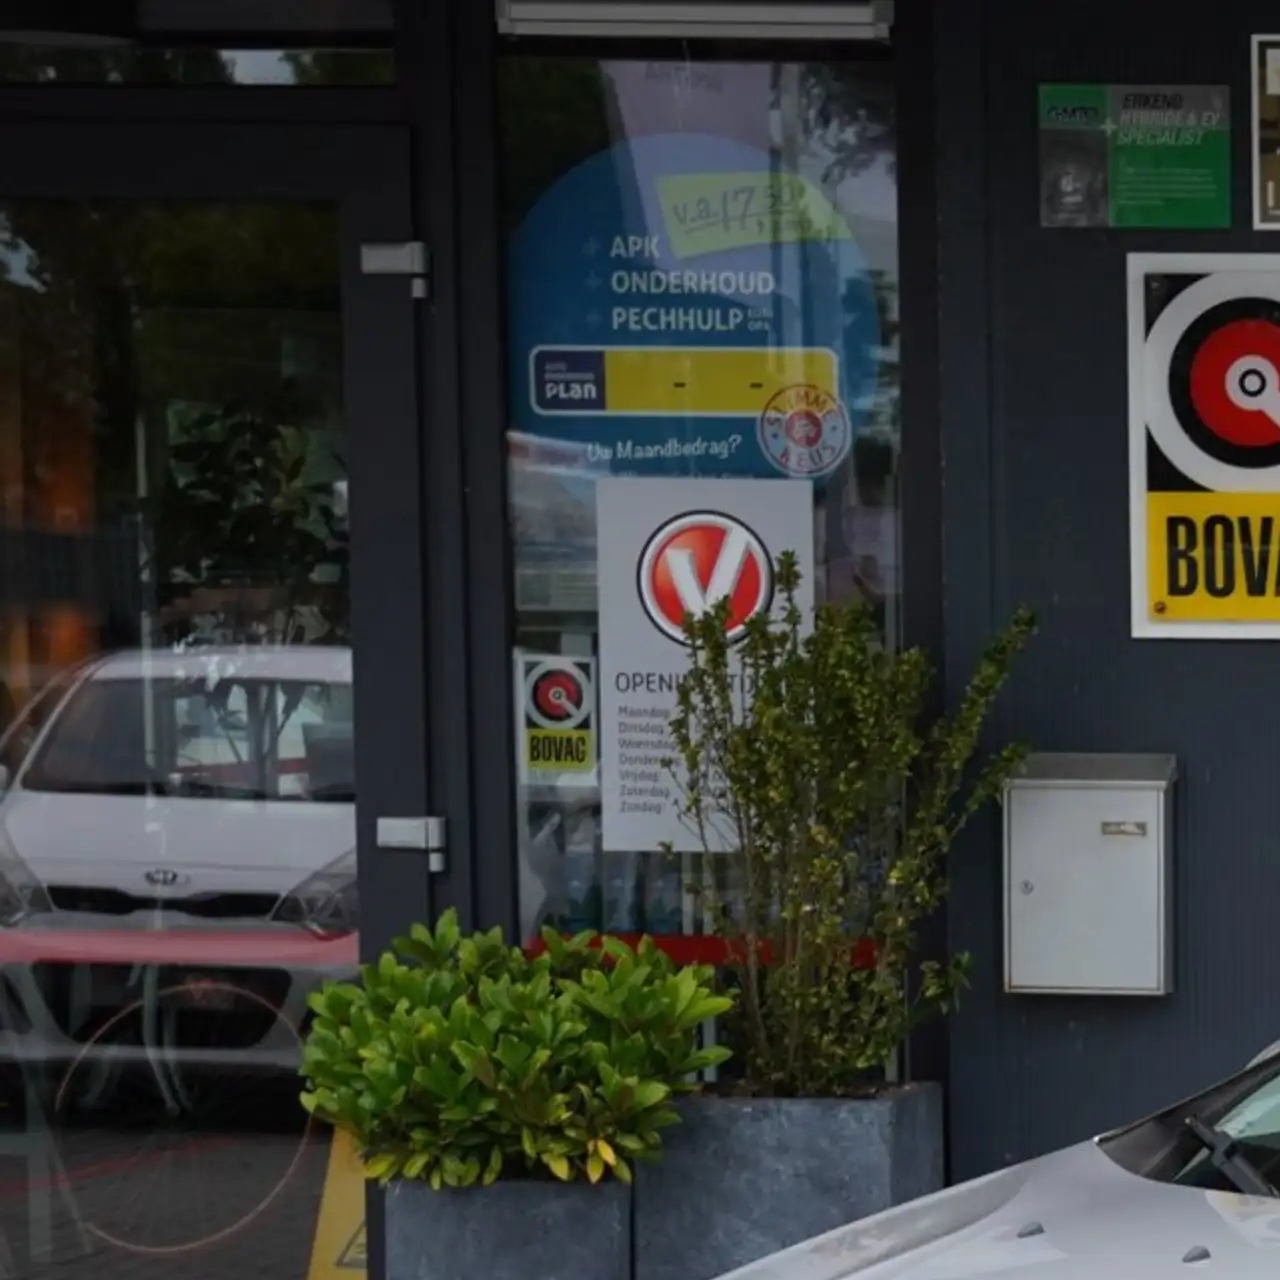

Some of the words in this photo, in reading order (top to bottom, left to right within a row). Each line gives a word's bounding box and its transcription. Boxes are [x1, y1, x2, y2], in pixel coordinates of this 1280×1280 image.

[610, 235, 660, 259] APK
[611, 269, 776, 295] ONDERHOUD
[612, 305, 744, 331] PECHHULP
[529, 735, 587, 763] BOVAG
